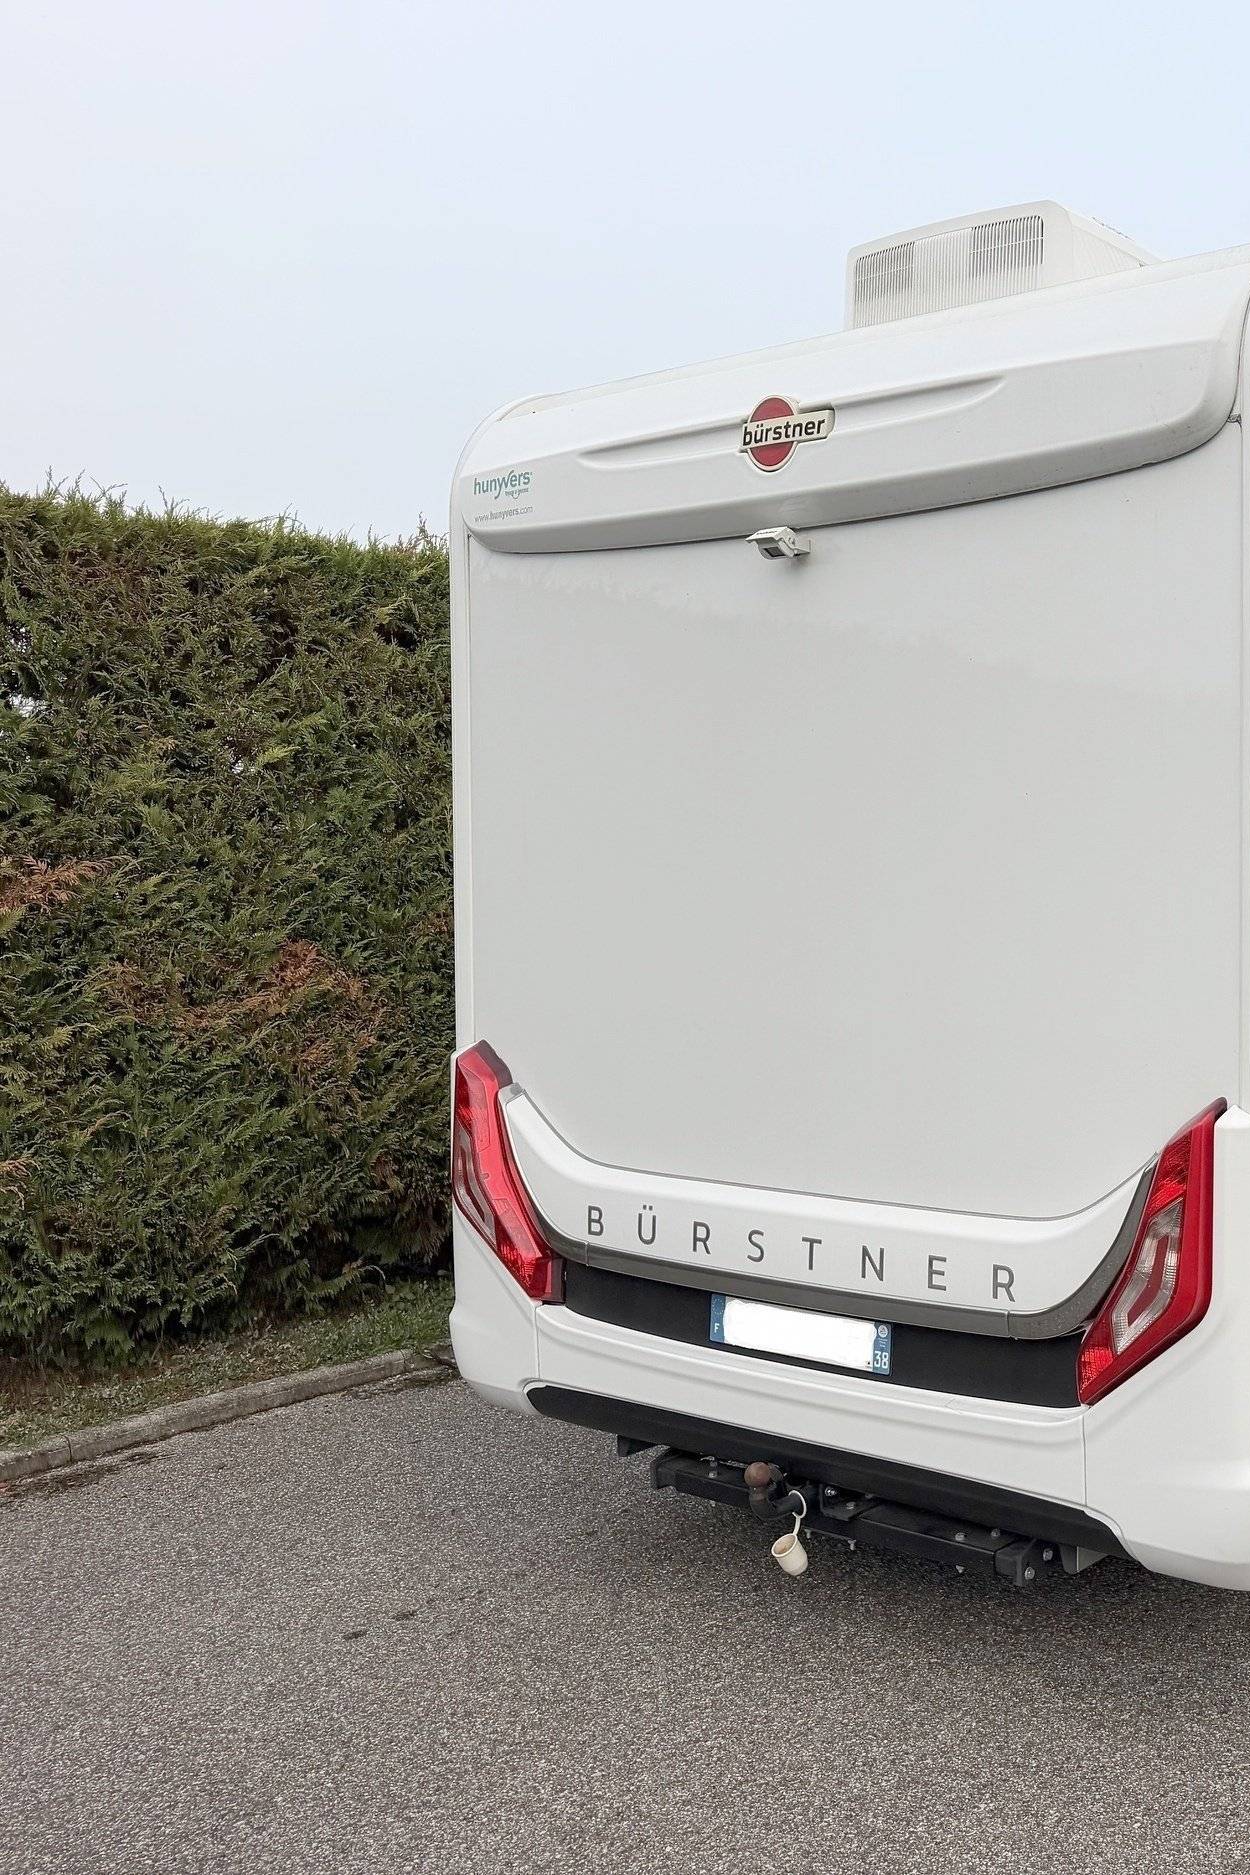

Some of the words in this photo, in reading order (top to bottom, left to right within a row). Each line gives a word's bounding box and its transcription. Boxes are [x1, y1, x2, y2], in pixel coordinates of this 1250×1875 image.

[743, 418, 826, 447] bürstner
[474, 469, 531, 500] hunyvers
[587, 1204, 1016, 1302] BÜRSTNER
[714, 1322, 720, 1333] F
[873, 1350, 889, 1369] 38
